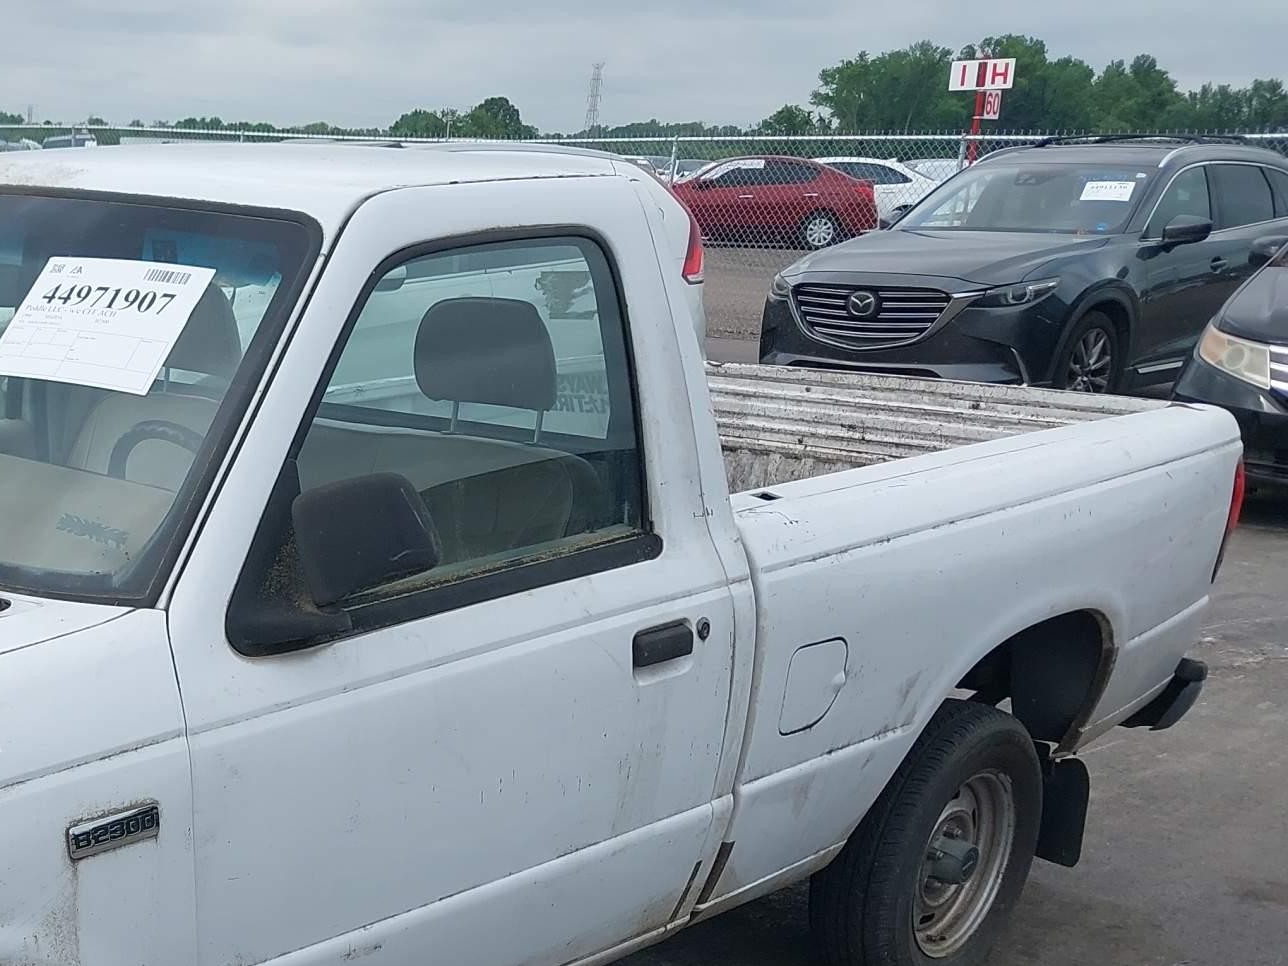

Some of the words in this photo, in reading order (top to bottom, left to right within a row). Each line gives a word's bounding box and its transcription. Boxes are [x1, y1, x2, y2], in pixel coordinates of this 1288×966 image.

[990, 62, 1010, 85] H
[985, 92, 1000, 116] 60
[42, 283, 177, 315] 44971907
[72, 809, 158, 852] B2300
